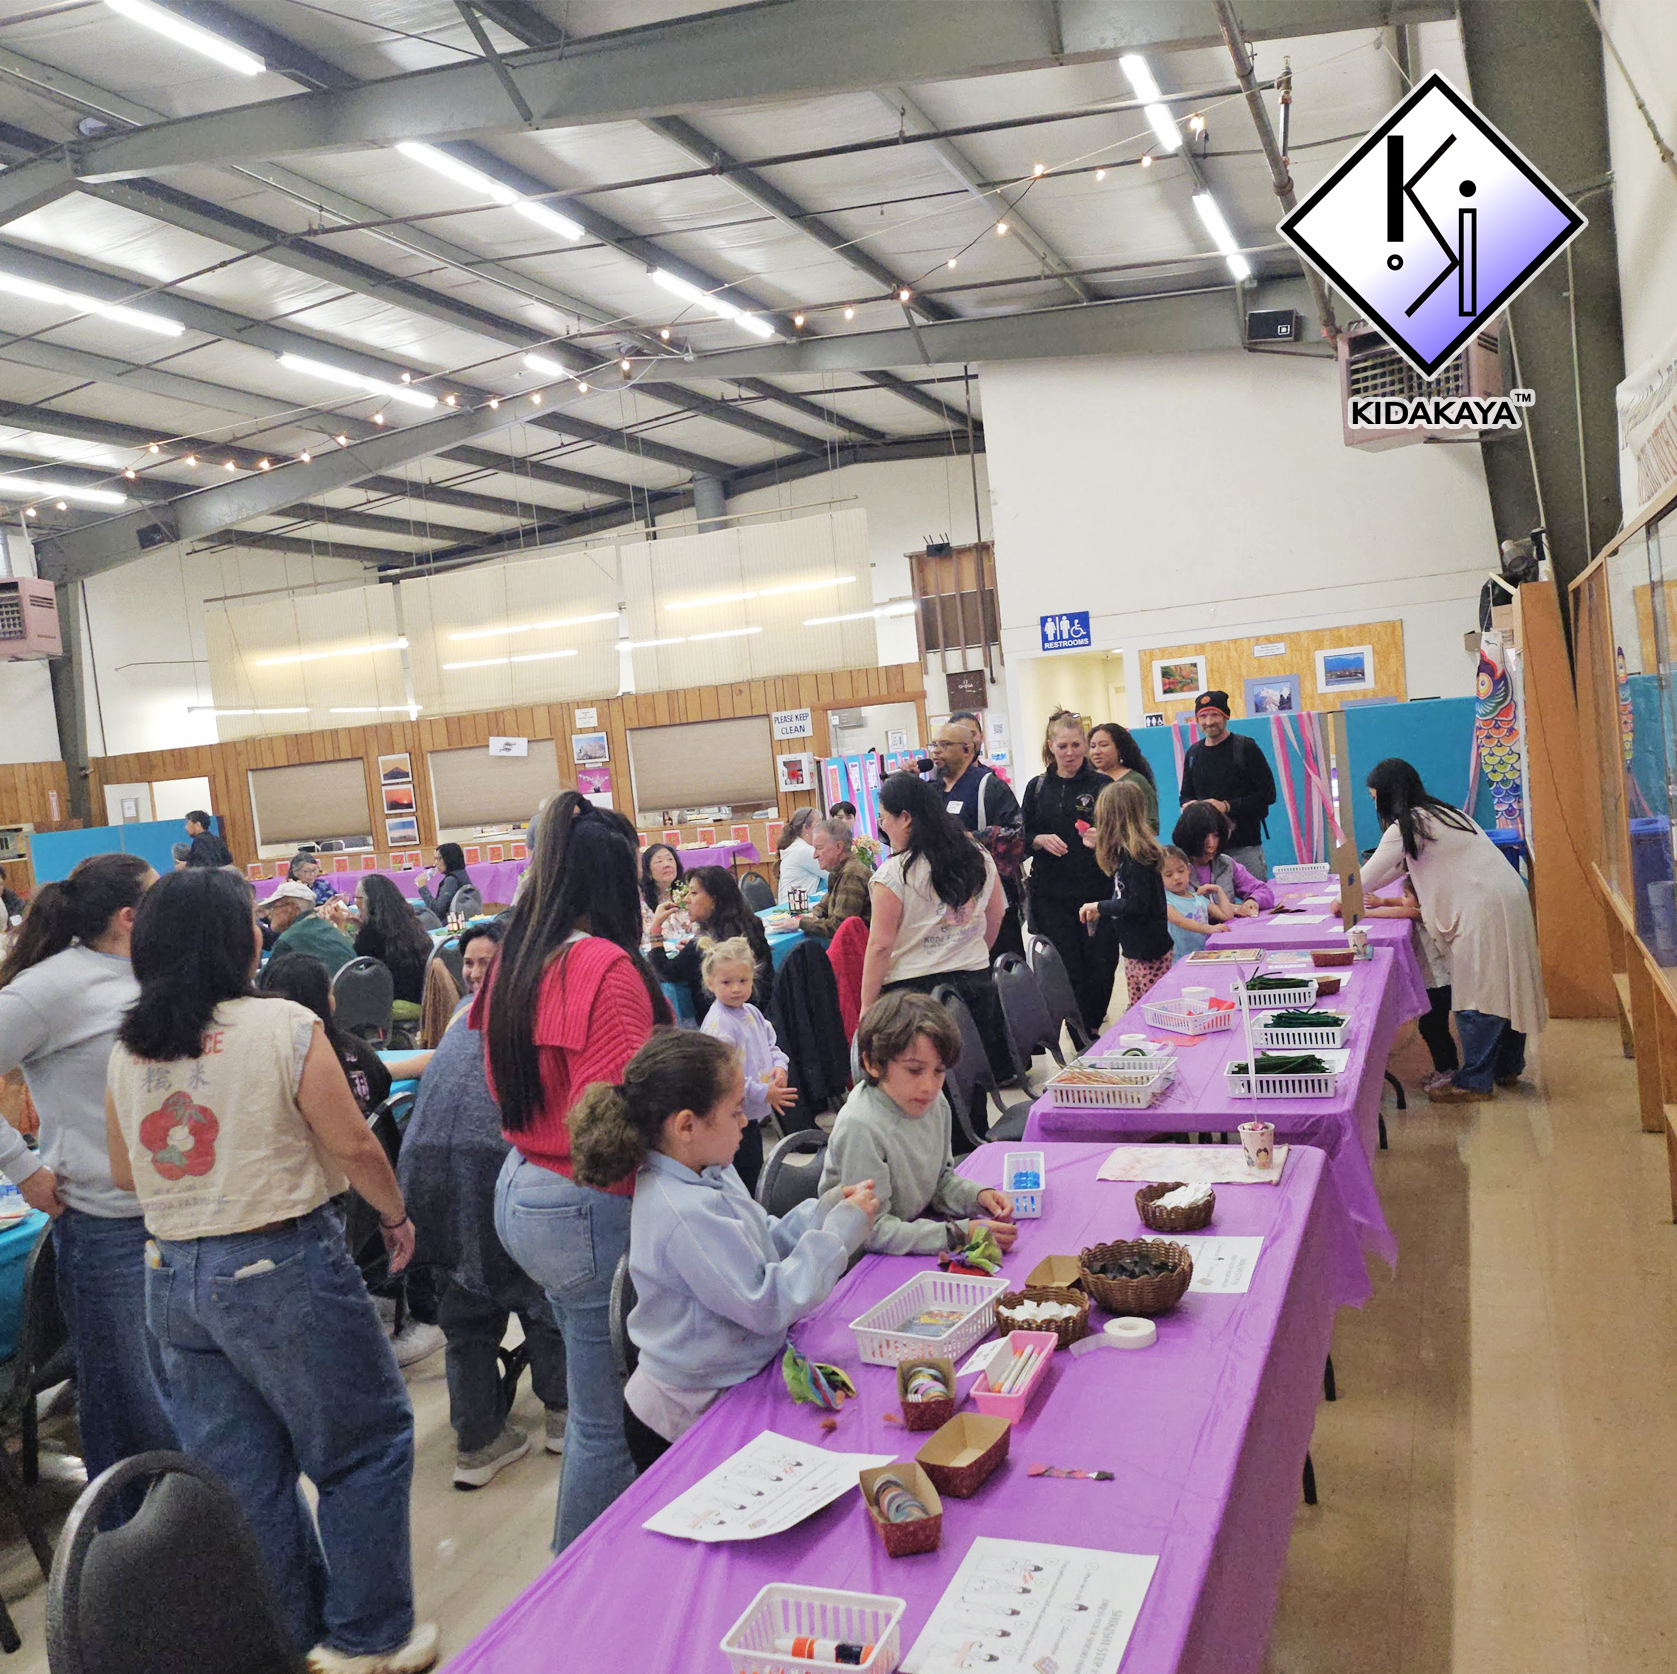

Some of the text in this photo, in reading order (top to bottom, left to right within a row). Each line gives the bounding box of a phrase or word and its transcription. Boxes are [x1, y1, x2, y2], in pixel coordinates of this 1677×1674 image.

[1044, 638, 1089, 649] RESTROOMS
[774, 712, 809, 724] PLEASE KEEP
[781, 725, 805, 735] CLEAN
